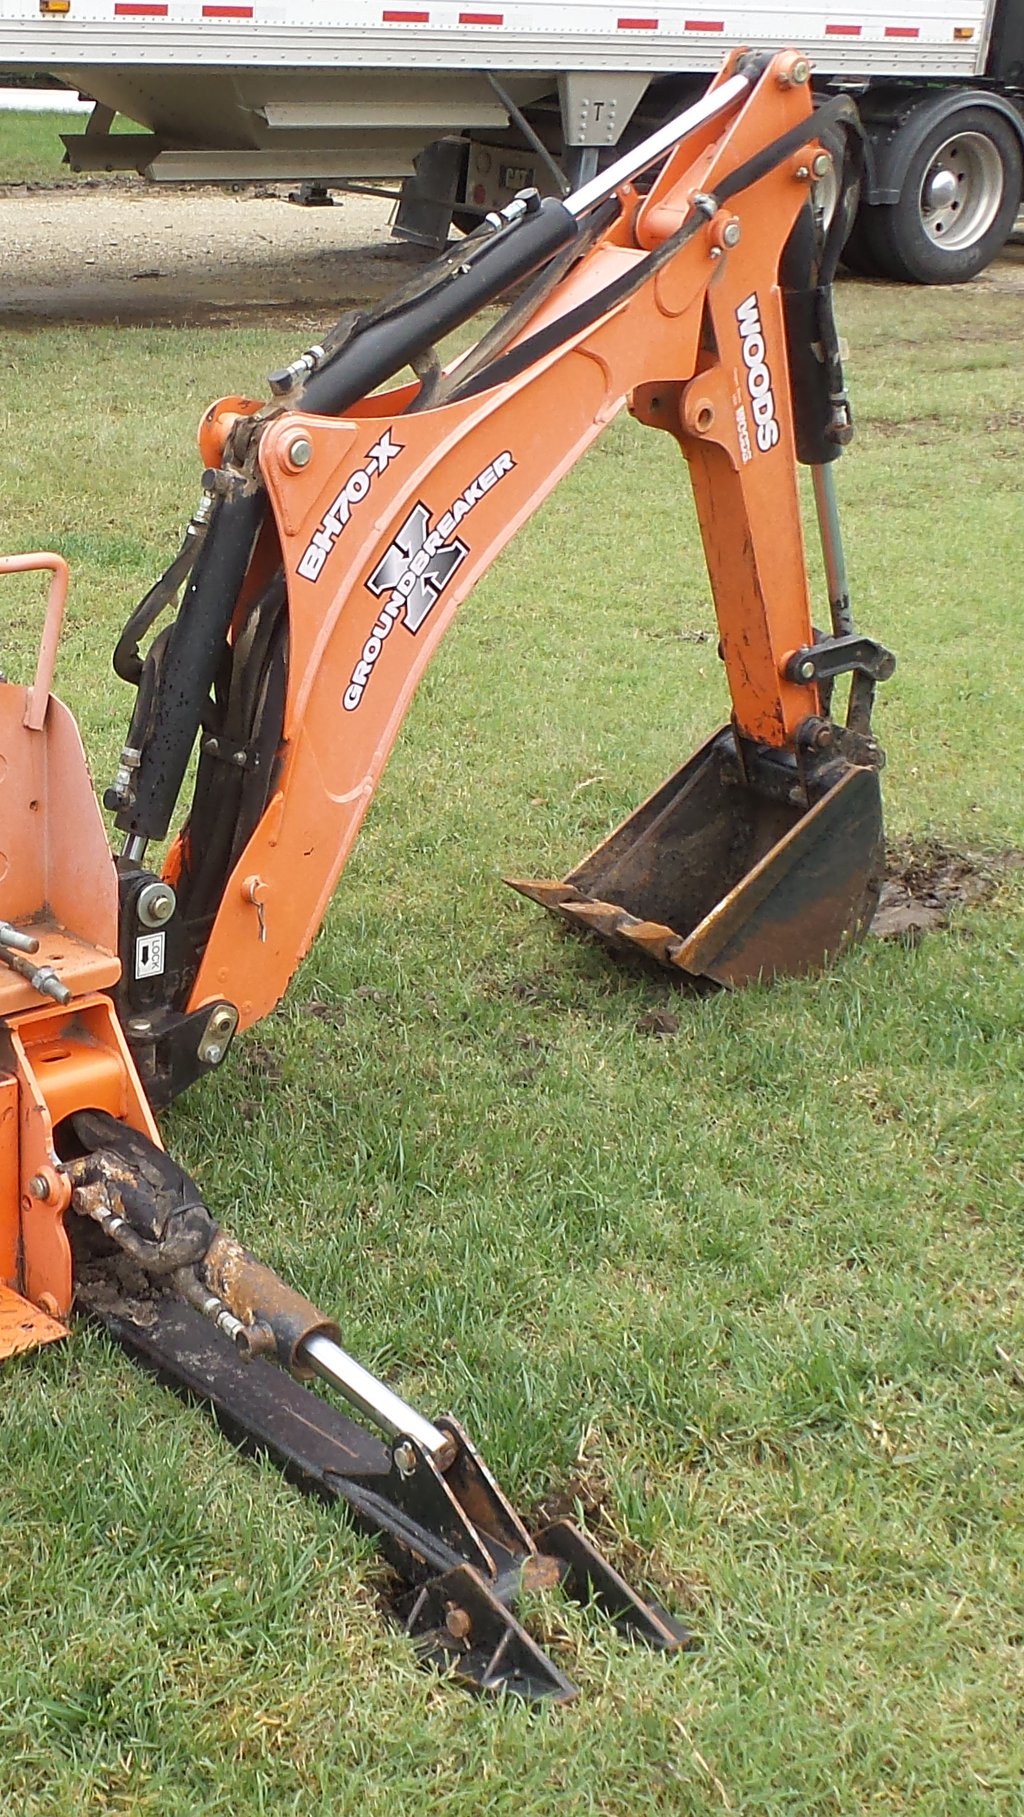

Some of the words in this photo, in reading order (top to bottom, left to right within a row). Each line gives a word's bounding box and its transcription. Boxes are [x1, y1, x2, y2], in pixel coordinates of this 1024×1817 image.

[736, 291, 780, 452] WOODS
[296, 426, 406, 583] BH70-X
[342, 450, 517, 711] GROUNDBREAKER
[151, 940, 161, 970] LOCK
